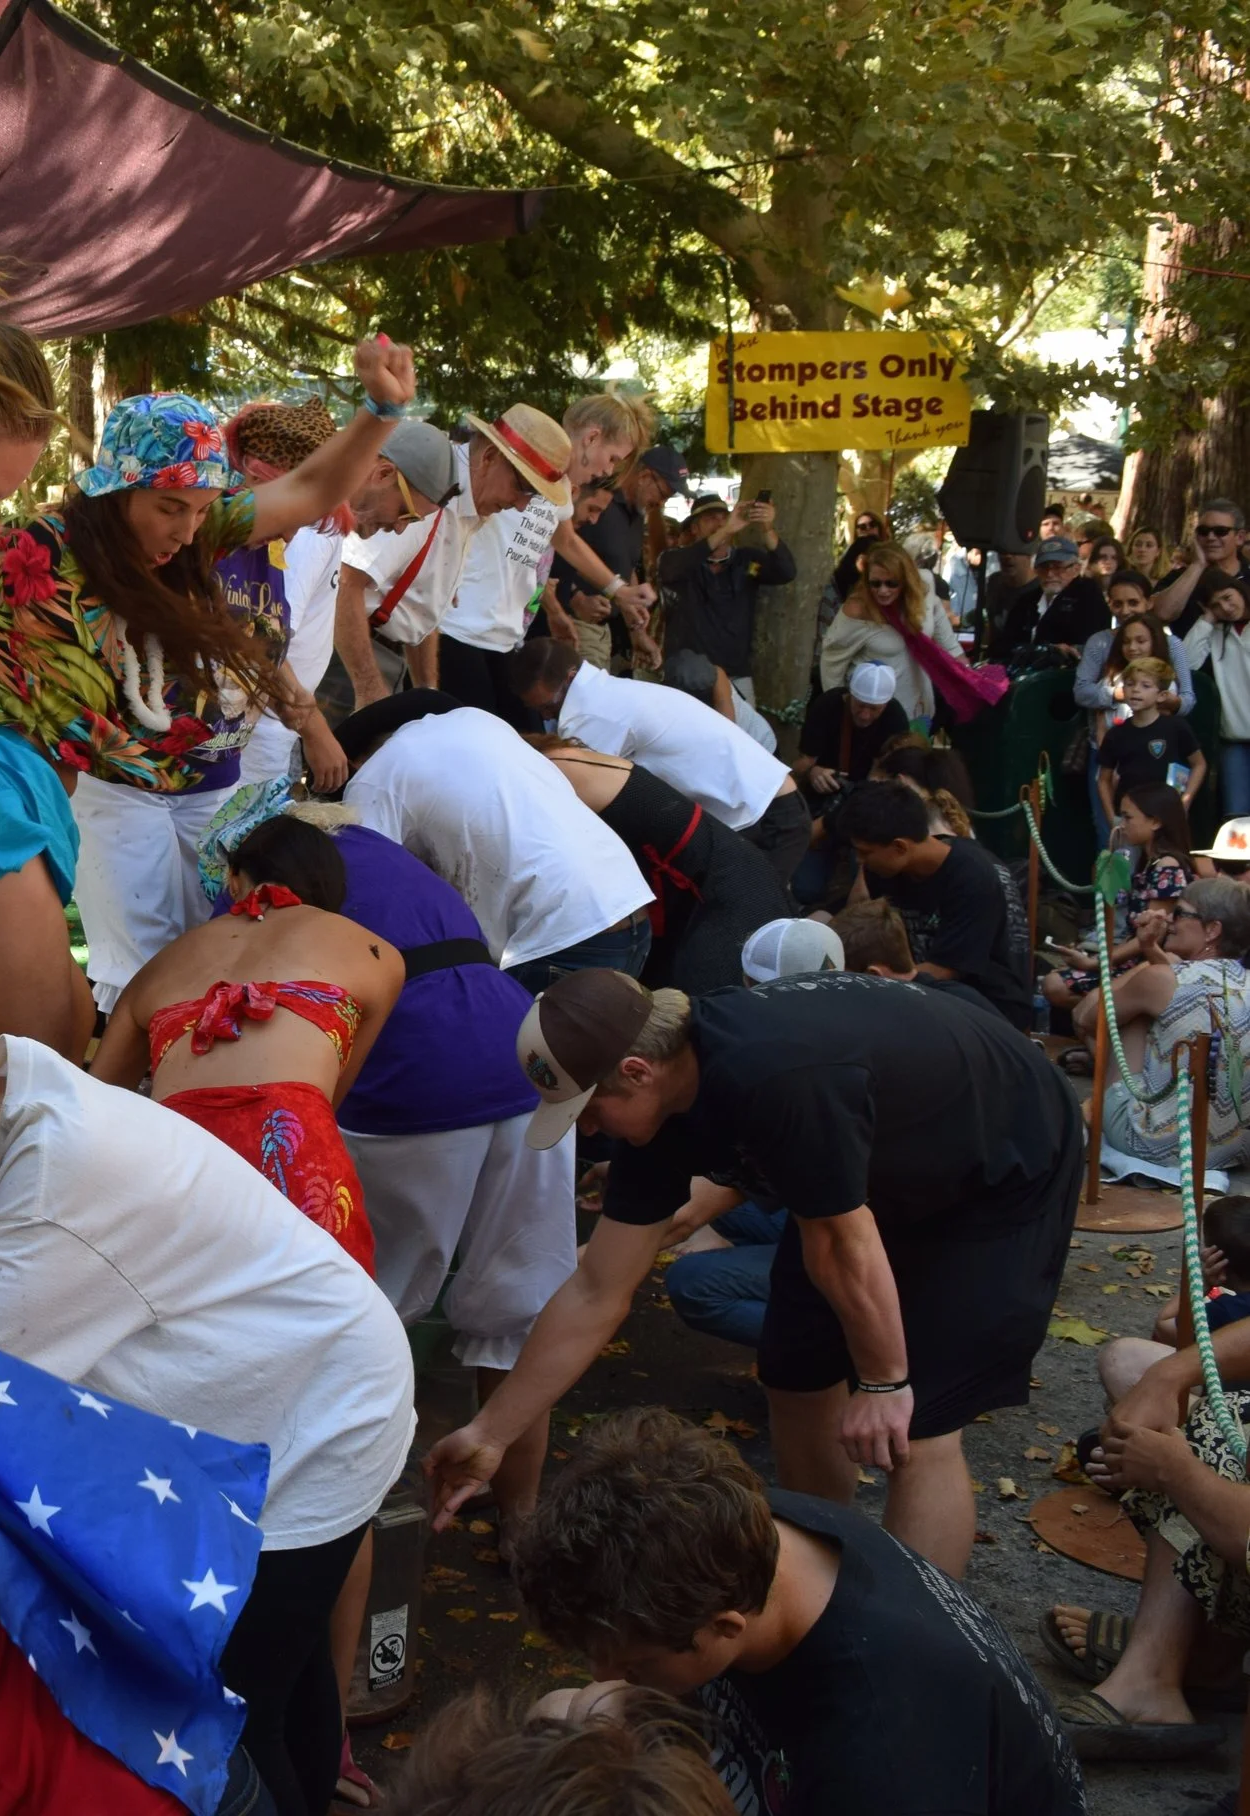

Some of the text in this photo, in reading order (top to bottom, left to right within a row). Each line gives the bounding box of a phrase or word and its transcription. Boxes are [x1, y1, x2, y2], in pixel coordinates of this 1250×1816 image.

[714, 335, 759, 360] Pease
[716, 352, 956, 387] Stompers Only
[733, 393, 944, 423] Behind Stage
[885, 421, 964, 447] Thank you
[520, 516, 535, 531] The
[513, 531, 528, 546] The
[505, 547, 523, 561] Pour
